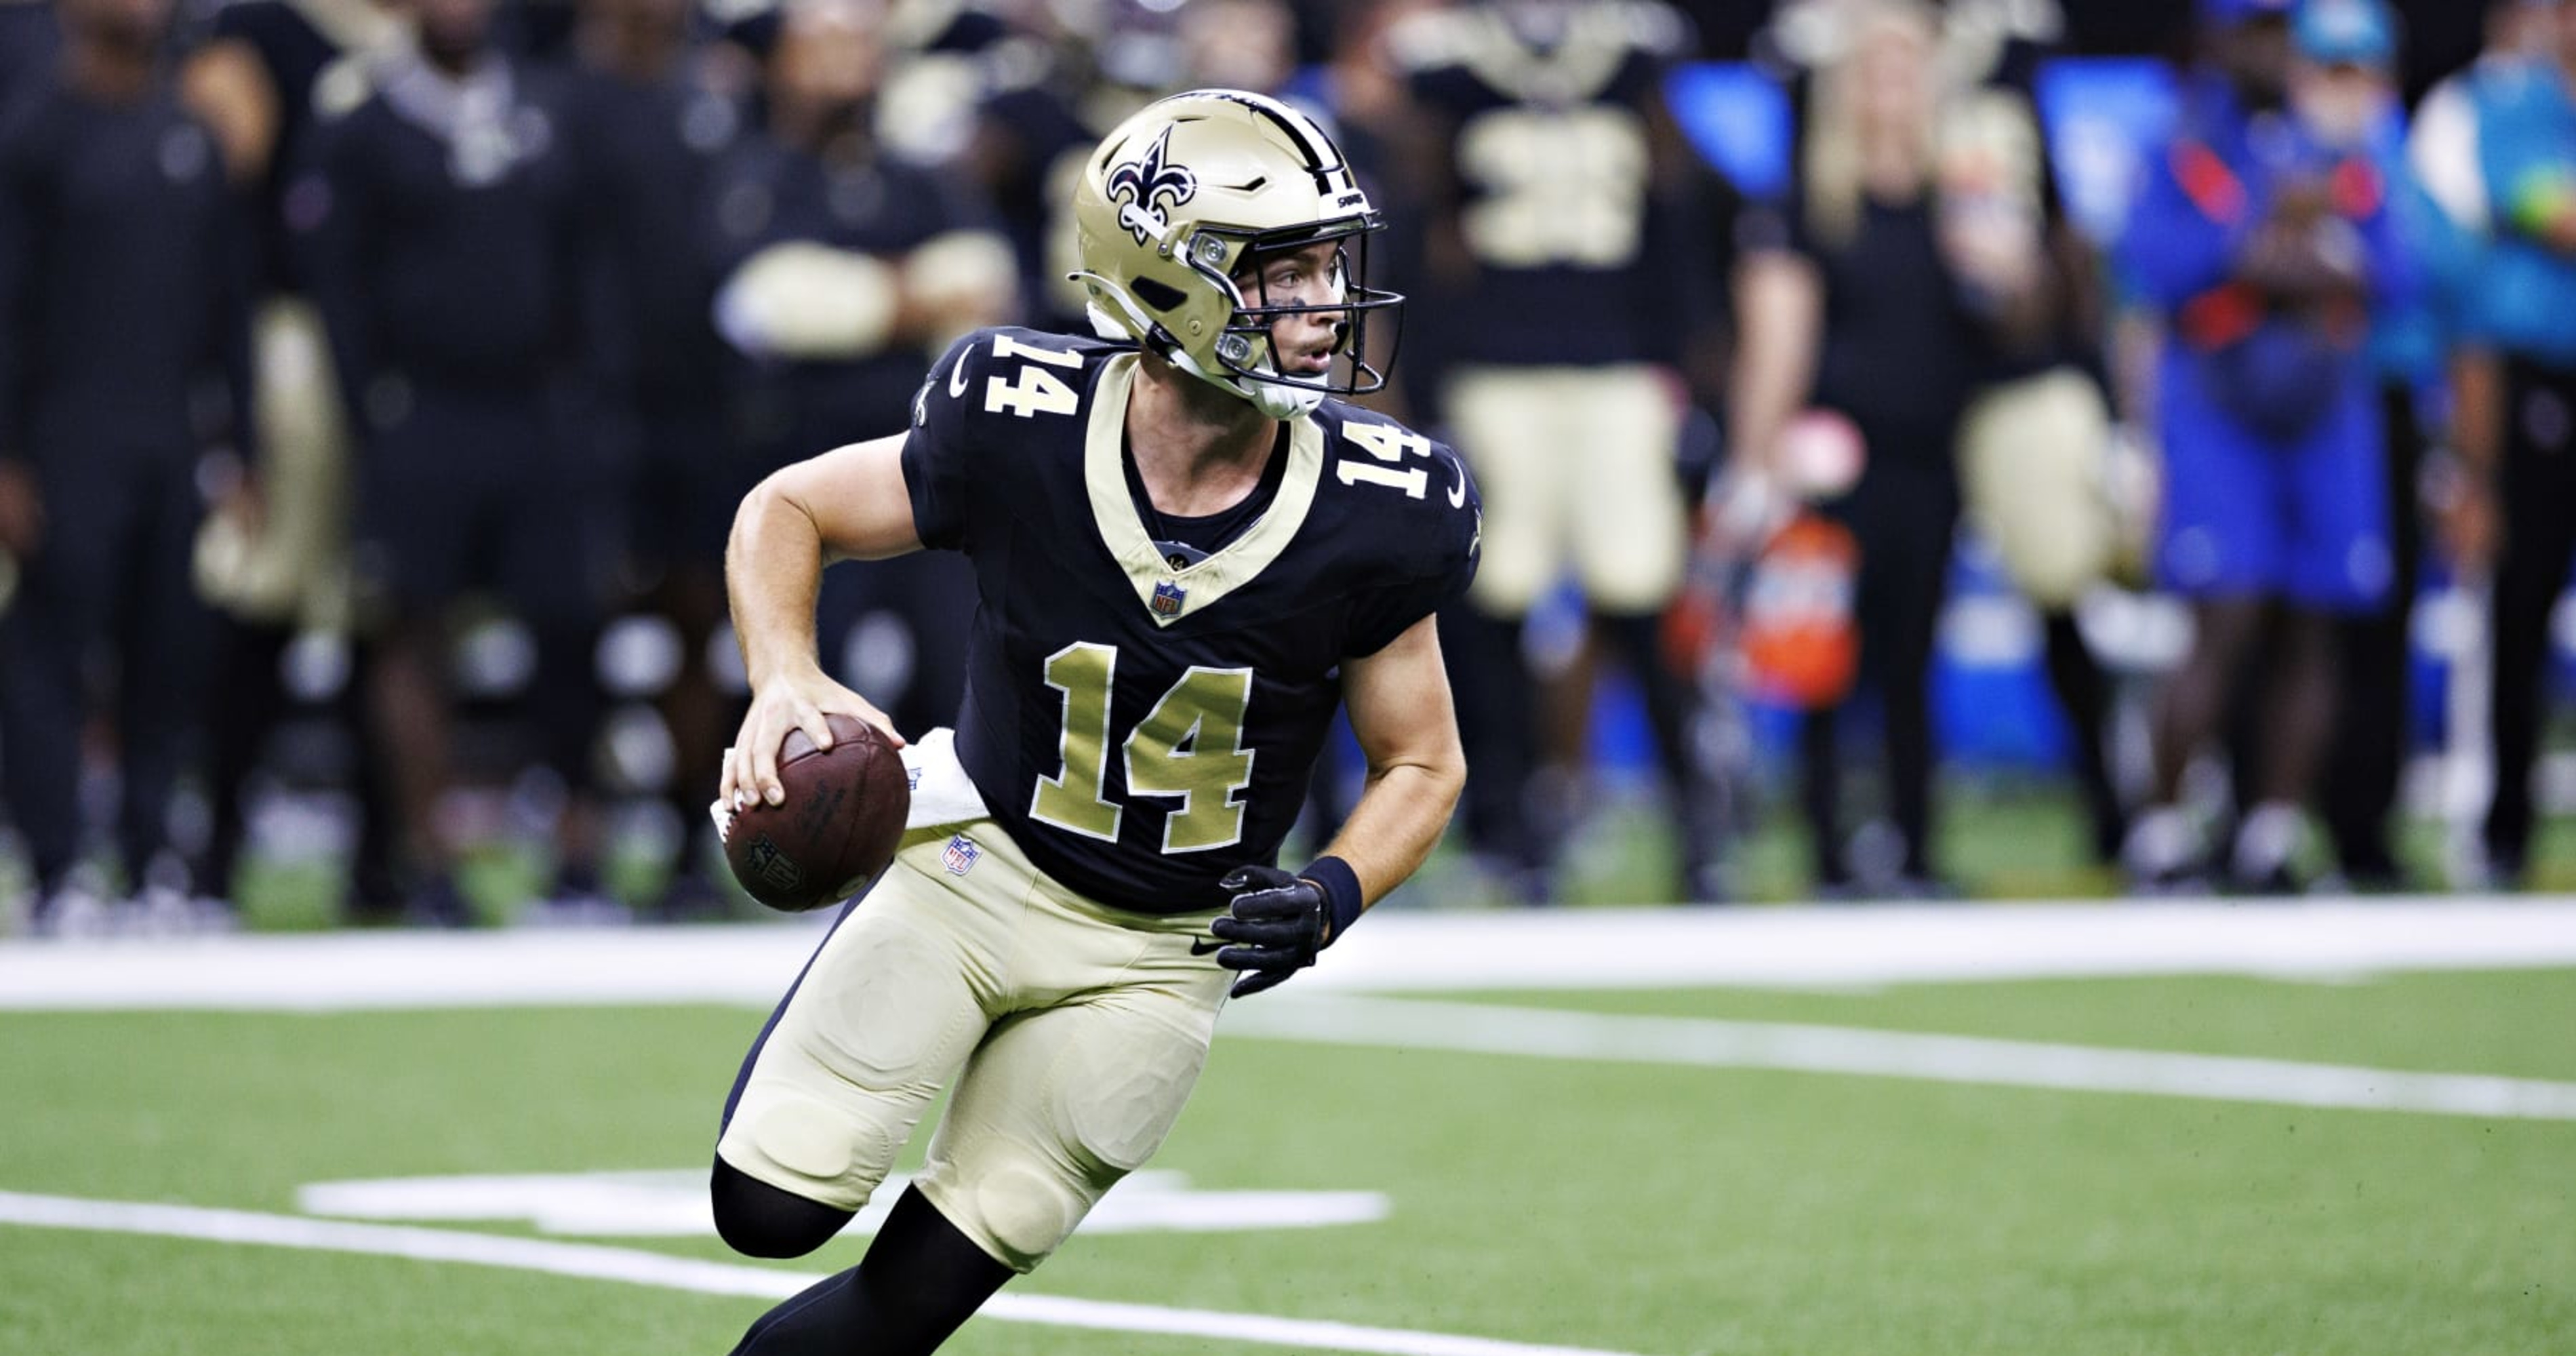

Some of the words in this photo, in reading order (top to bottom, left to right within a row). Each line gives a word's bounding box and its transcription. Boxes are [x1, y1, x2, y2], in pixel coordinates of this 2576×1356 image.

[984, 334, 1084, 418] 14
[1337, 420, 1431, 500] 14
[1155, 595, 1179, 612] NFL
[1029, 641, 1255, 854] 14
[948, 848, 967, 870] NFL
